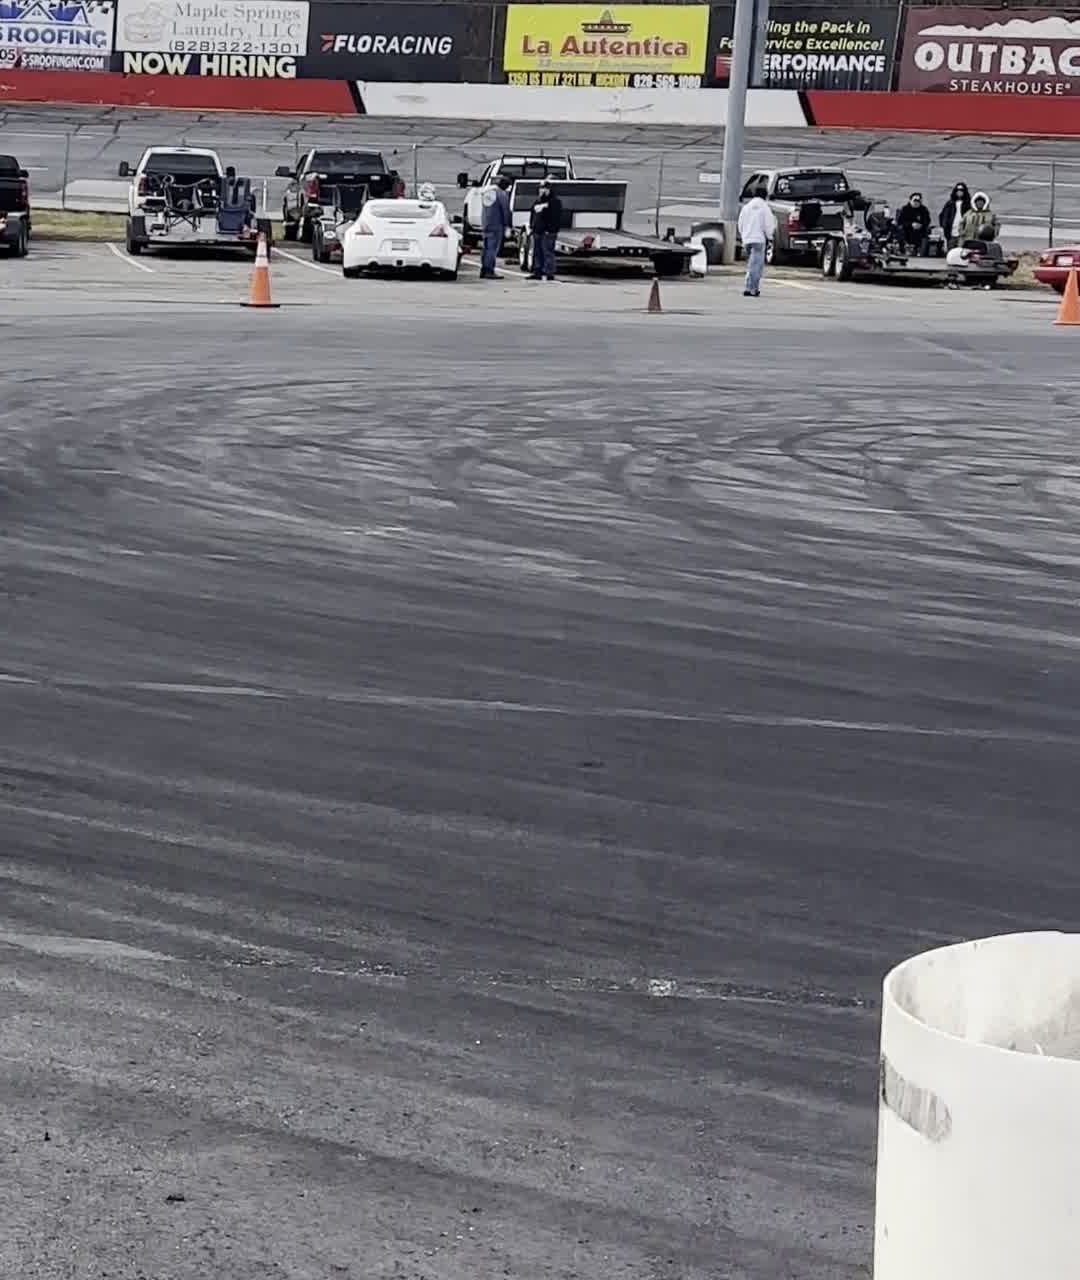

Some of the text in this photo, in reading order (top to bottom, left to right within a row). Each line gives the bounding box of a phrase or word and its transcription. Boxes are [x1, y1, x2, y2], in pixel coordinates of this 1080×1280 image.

[175, 2, 301, 25] Maple Springs
[171, 22, 252, 39] Laundry,
[794, 20, 818, 33] the
[820, 21, 854, 34] Pack
[857, 20, 870, 34] in
[8, 29, 107, 48] ROOFING
[334, 35, 453, 55] FLORACING
[522, 35, 689, 57] La Autentica
[806, 38, 884, 52] Excellence!
[124, 52, 297, 78] NOW HIRING
[762, 53, 885, 72] ERFORMANCE
[914, 42, 1080, 77] OUTBAC
[950, 79, 1065, 95] STEAKHOUSE
